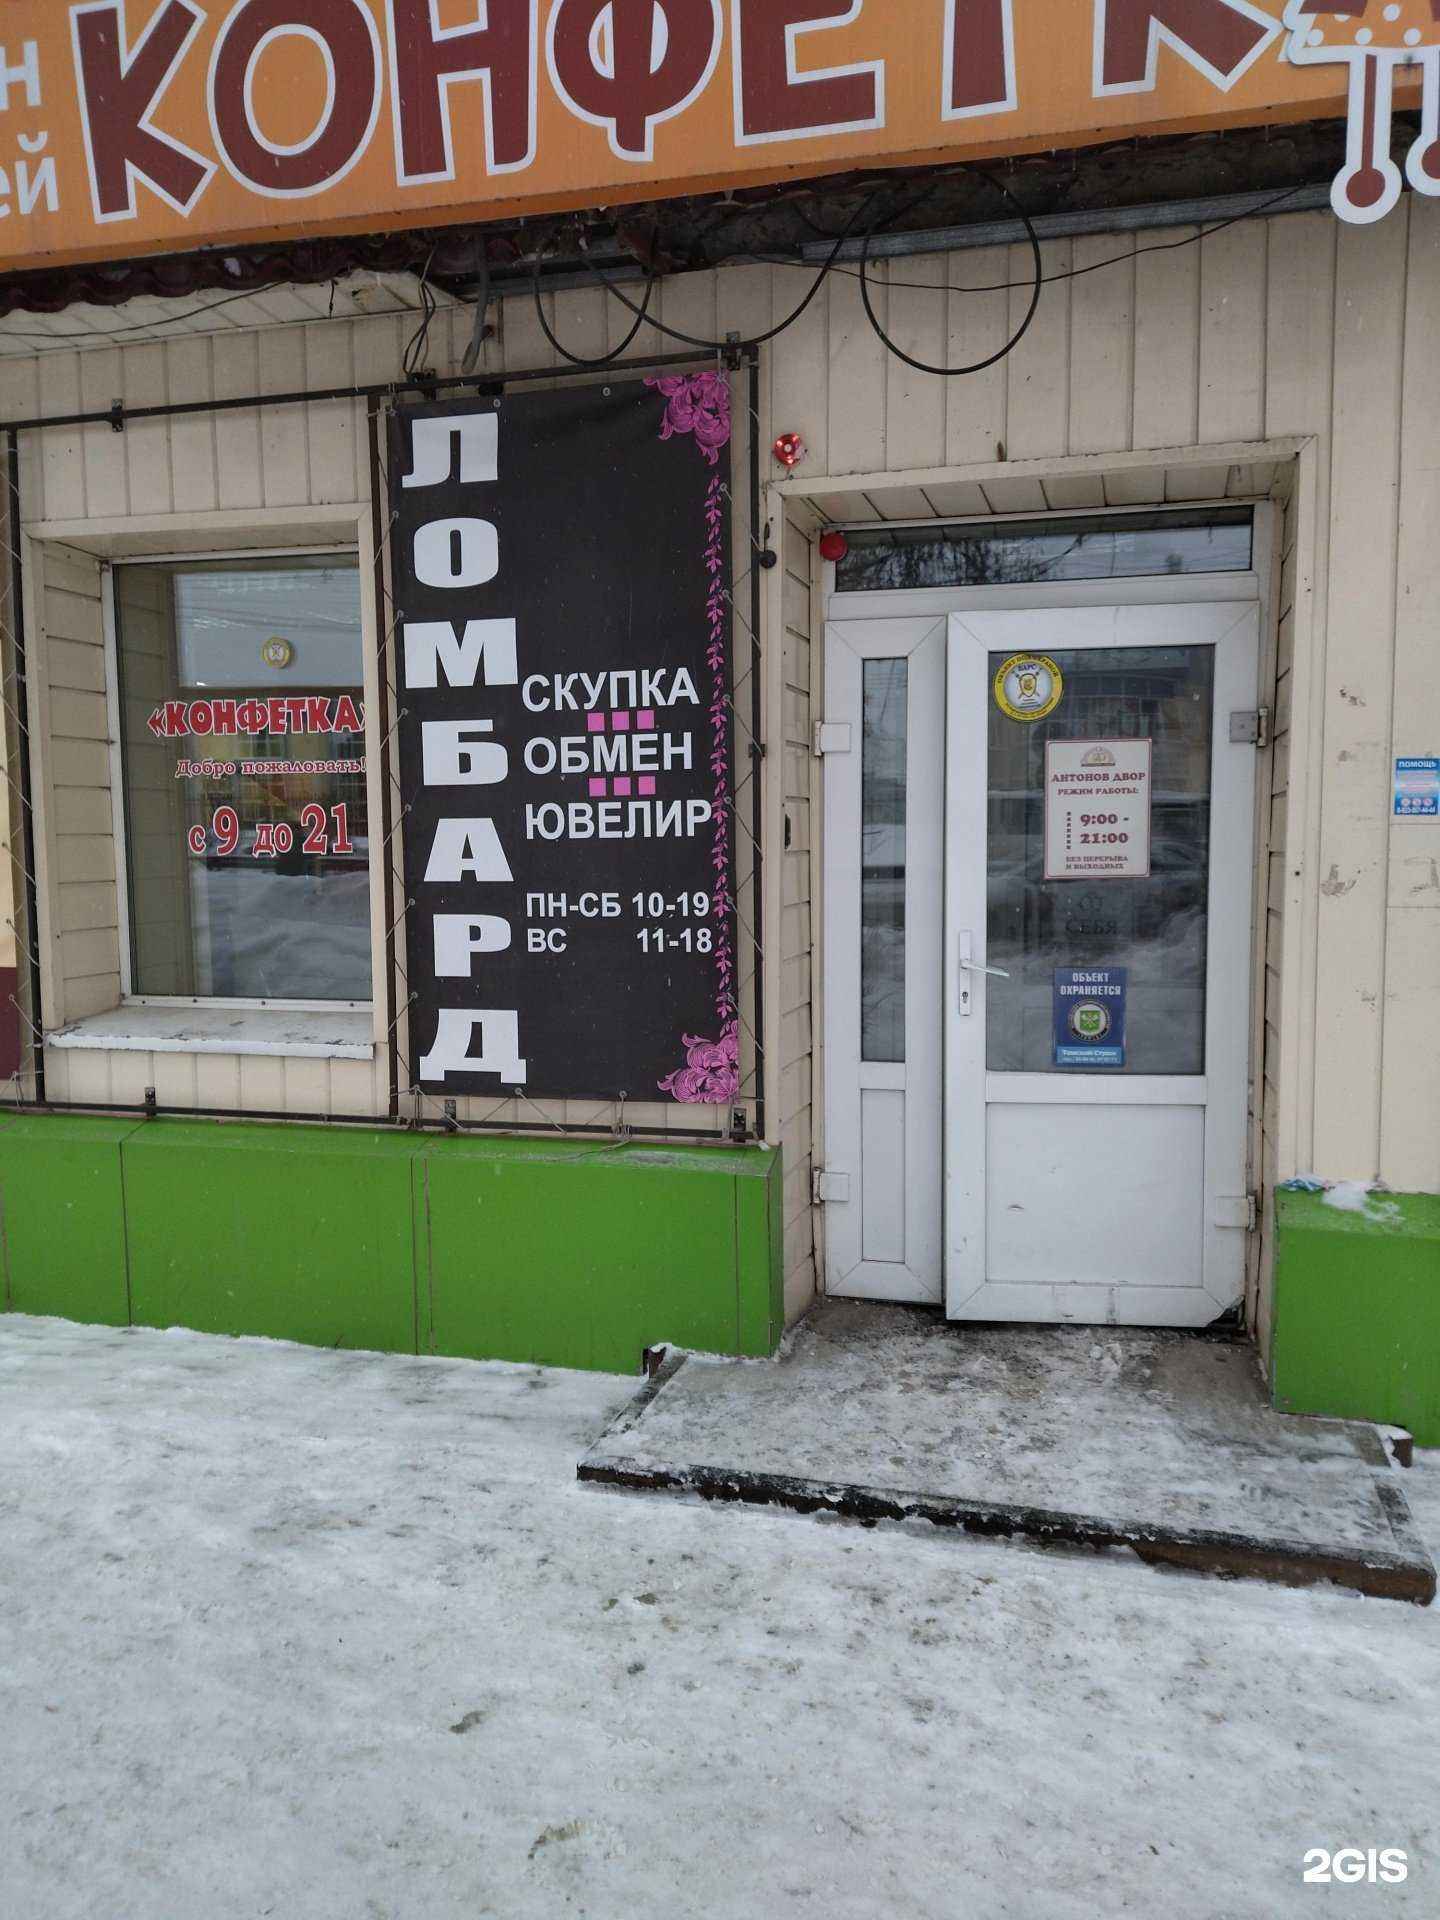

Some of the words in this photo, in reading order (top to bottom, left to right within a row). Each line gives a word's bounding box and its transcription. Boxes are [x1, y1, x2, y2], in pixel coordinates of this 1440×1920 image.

[522, 667, 700, 712] СКУПКА
[402, 412, 527, 1085] ЛОМБАРД
[524, 731, 693, 775] ОБМЕН
[174, 759, 235, 778] Добро
[1051, 773, 1110, 783] АНТОНОВ
[1113, 772, 1146, 782] ДВОР
[213, 806, 239, 856] 9
[252, 823, 293, 858] до
[300, 803, 352, 855] 21
[525, 800, 712, 840] ЮВЕЛИР
[1080, 813, 1118, 826] 9:00
[1080, 832, 1129, 844] 21:00
[526, 892, 621, 917] ПН-СБ
[632, 892, 710, 917] 10-19
[527, 928, 567, 953] ВС
[636, 927, 712, 953] 11-18
[1072, 972, 1109, 982] ОБЪЕКТ
[1060, 985, 1121, 995] ОХРАНЯЕТСЯ
